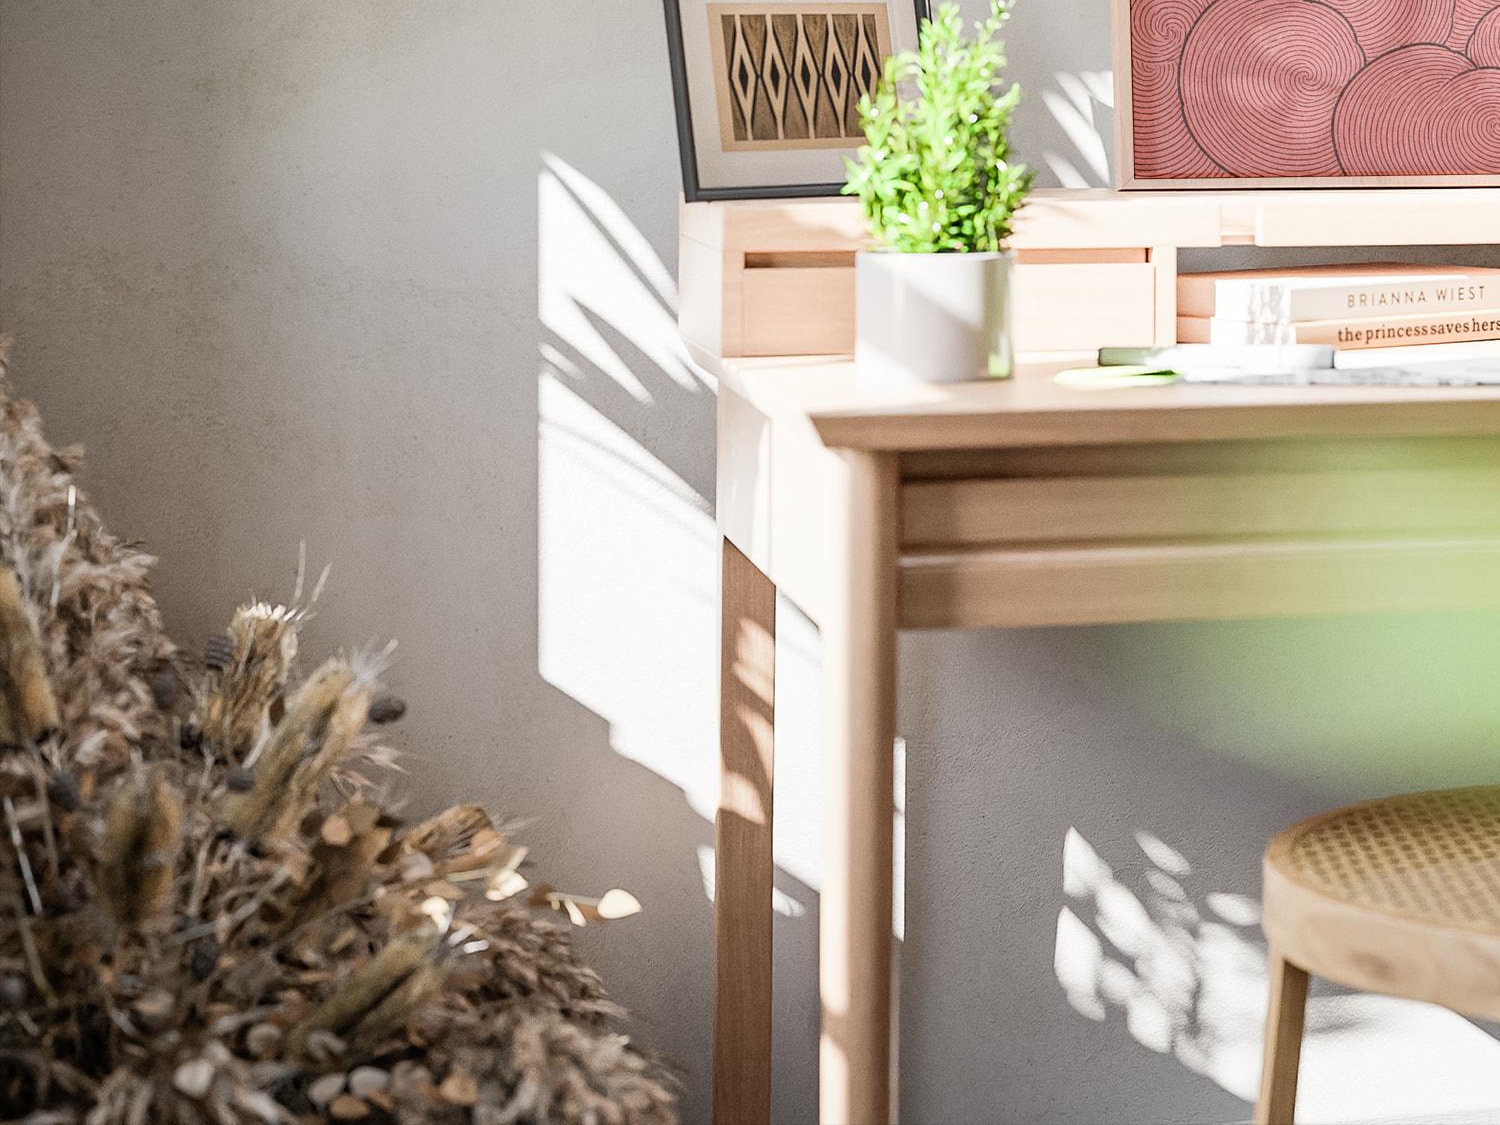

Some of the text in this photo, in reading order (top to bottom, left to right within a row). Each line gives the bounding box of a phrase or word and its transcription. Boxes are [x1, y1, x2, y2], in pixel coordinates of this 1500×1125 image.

[1347, 285, 1486, 308] BRIANNA WIEST
[1338, 326, 1363, 342] the
[1365, 323, 1428, 344] princess
[1429, 322, 1470, 335] saves
